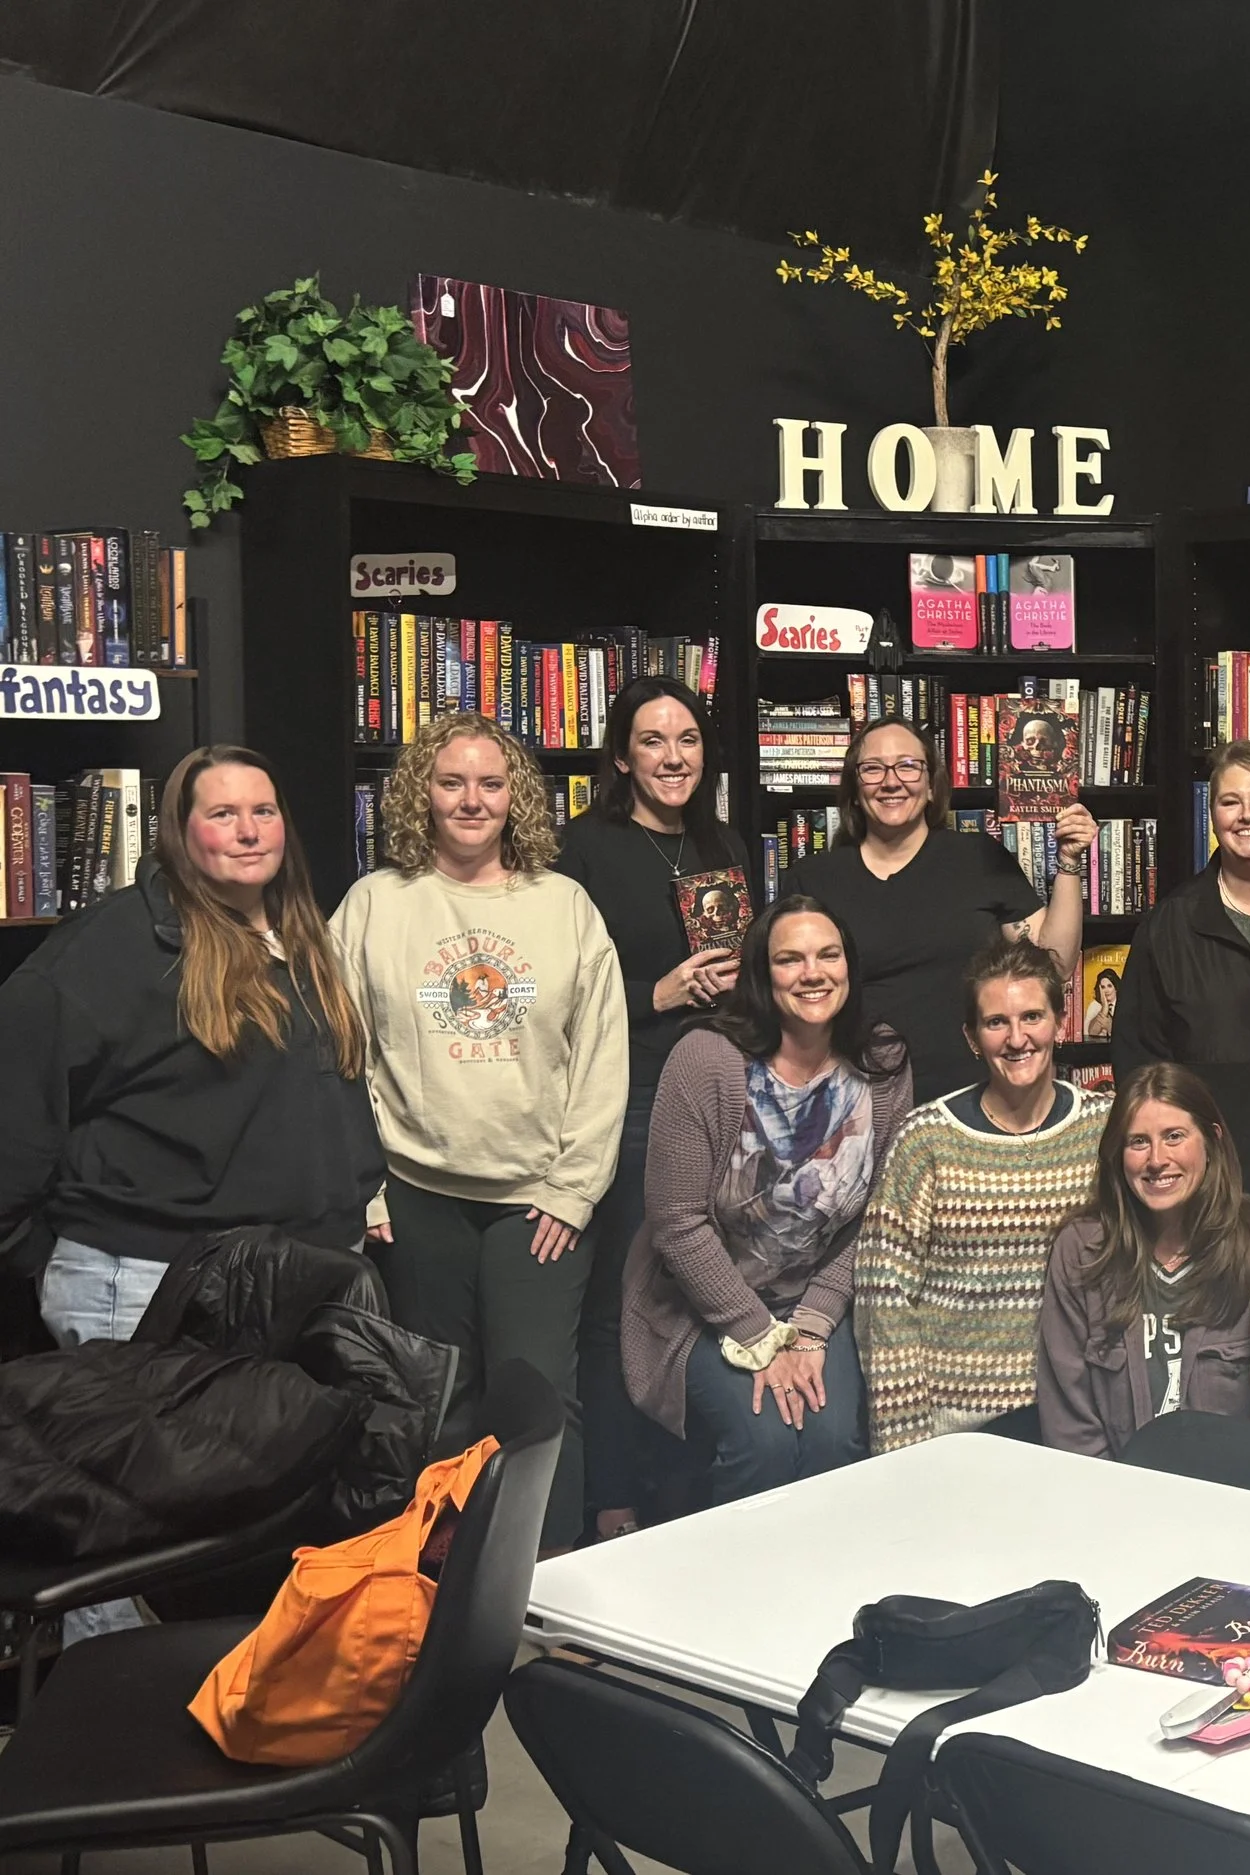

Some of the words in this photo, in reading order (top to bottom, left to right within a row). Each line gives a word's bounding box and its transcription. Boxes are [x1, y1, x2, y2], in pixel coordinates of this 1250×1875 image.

[773, 418, 1115, 516] HOME
[634, 508, 658, 523] Alpha
[661, 512, 680, 522] order
[682, 513, 691, 527] by
[693, 514, 716, 525] author
[17, 553, 28, 599] CROOKED
[355, 559, 445, 591] Scaries
[917, 599, 972, 609] AGATHA
[917, 610, 972, 620] CHRISTIE
[1015, 601, 1066, 610] AGATHA
[1015, 611, 1066, 621] CHRISTIE
[369, 627, 378, 652] DAVID
[761, 608, 842, 652] Scaries
[859, 634, 867, 643] 2
[420, 632, 429, 656] DAVID
[436, 632, 445, 660] DAVID
[484, 636, 495, 661] DAVID
[501, 636, 512, 666] DAVID
[370, 655, 379, 696] BALDACCI
[390, 651, 398, 685] BALDACCI
[421, 659, 430, 698] BALDACCI
[465, 663, 476, 698] ABSOLUTE
[578, 657, 587, 681] DAVID
[0, 667, 152, 717] fantasy
[437, 663, 445, 708] BALDACCI
[485, 665, 496, 705] BALDACCI
[501, 668, 512, 717] BALDACCI
[869, 678, 878, 698] JAMES
[902, 680, 913, 696] JAMES
[1120, 692, 1125, 700] AL
[580, 682, 588, 721] BALDACCI
[969, 706, 978, 726] JAMES
[785, 735, 803, 745] JAMES
[803, 735, 833, 745] PATTERSON
[969, 727, 979, 760] PATTERSON
[773, 774, 793, 783] JAMES
[794, 774, 829, 784] PATTERSON
[1006, 777, 1069, 794] PHANTASMA
[366, 803, 374, 836] SANDRA
[777, 821, 787, 836] JOHN
[797, 814, 805, 835] JOHN
[129, 820, 137, 864] WICKED
[813, 831, 825, 848] John
[1047, 823, 1056, 848] BRAD
[366, 839, 374, 870] BROWN
[778, 838, 788, 869] SANDFORD
[1034, 843, 1043, 862] THOR
[424, 936, 532, 977] BALDUR'S
[448, 1038, 520, 1059] GATE
[1072, 1066, 1100, 1087] BURN
[1138, 1612, 1173, 1634] TED
[1174, 1584, 1225, 1616] DEKKER
[1117, 1640, 1185, 1674] Burn
